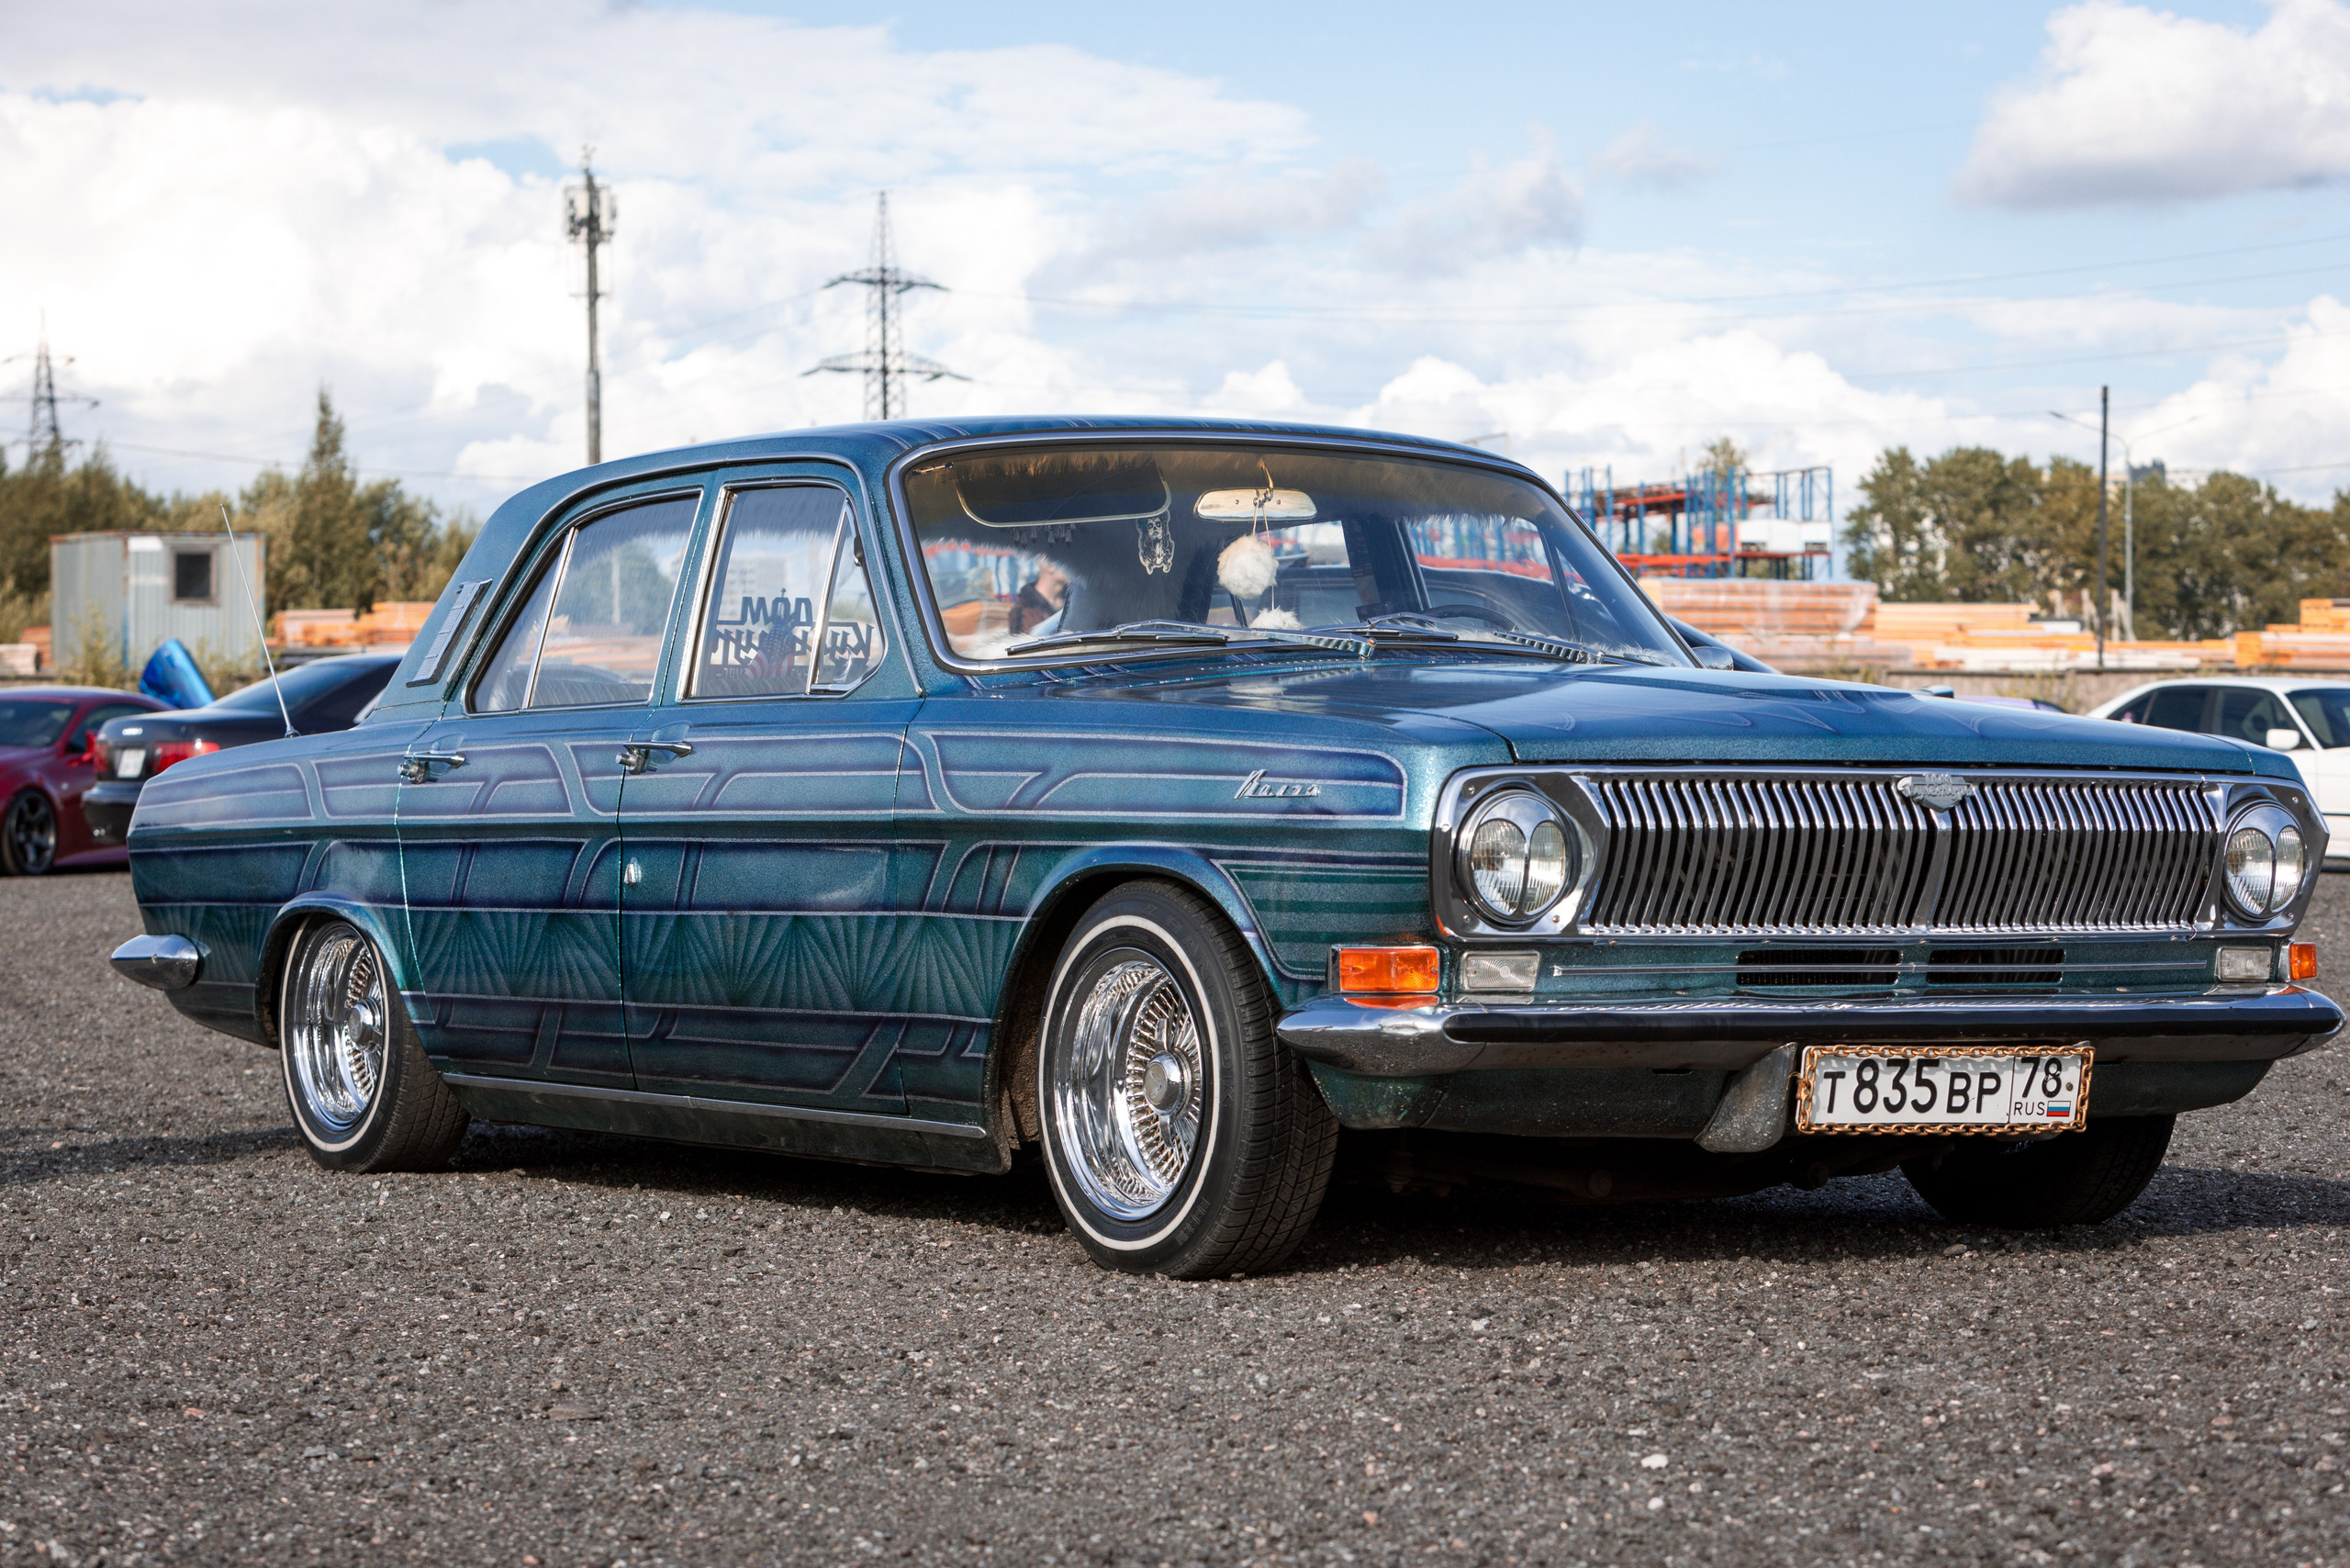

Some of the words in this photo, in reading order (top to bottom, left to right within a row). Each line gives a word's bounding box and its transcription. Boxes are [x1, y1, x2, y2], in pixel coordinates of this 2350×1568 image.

[1164, 914, 1235, 1106] HANKOOK
[1823, 1058, 2001, 1114] Т835ВР
[2020, 1057, 2063, 1098] 78
[2013, 1102, 2045, 1115] RUS
